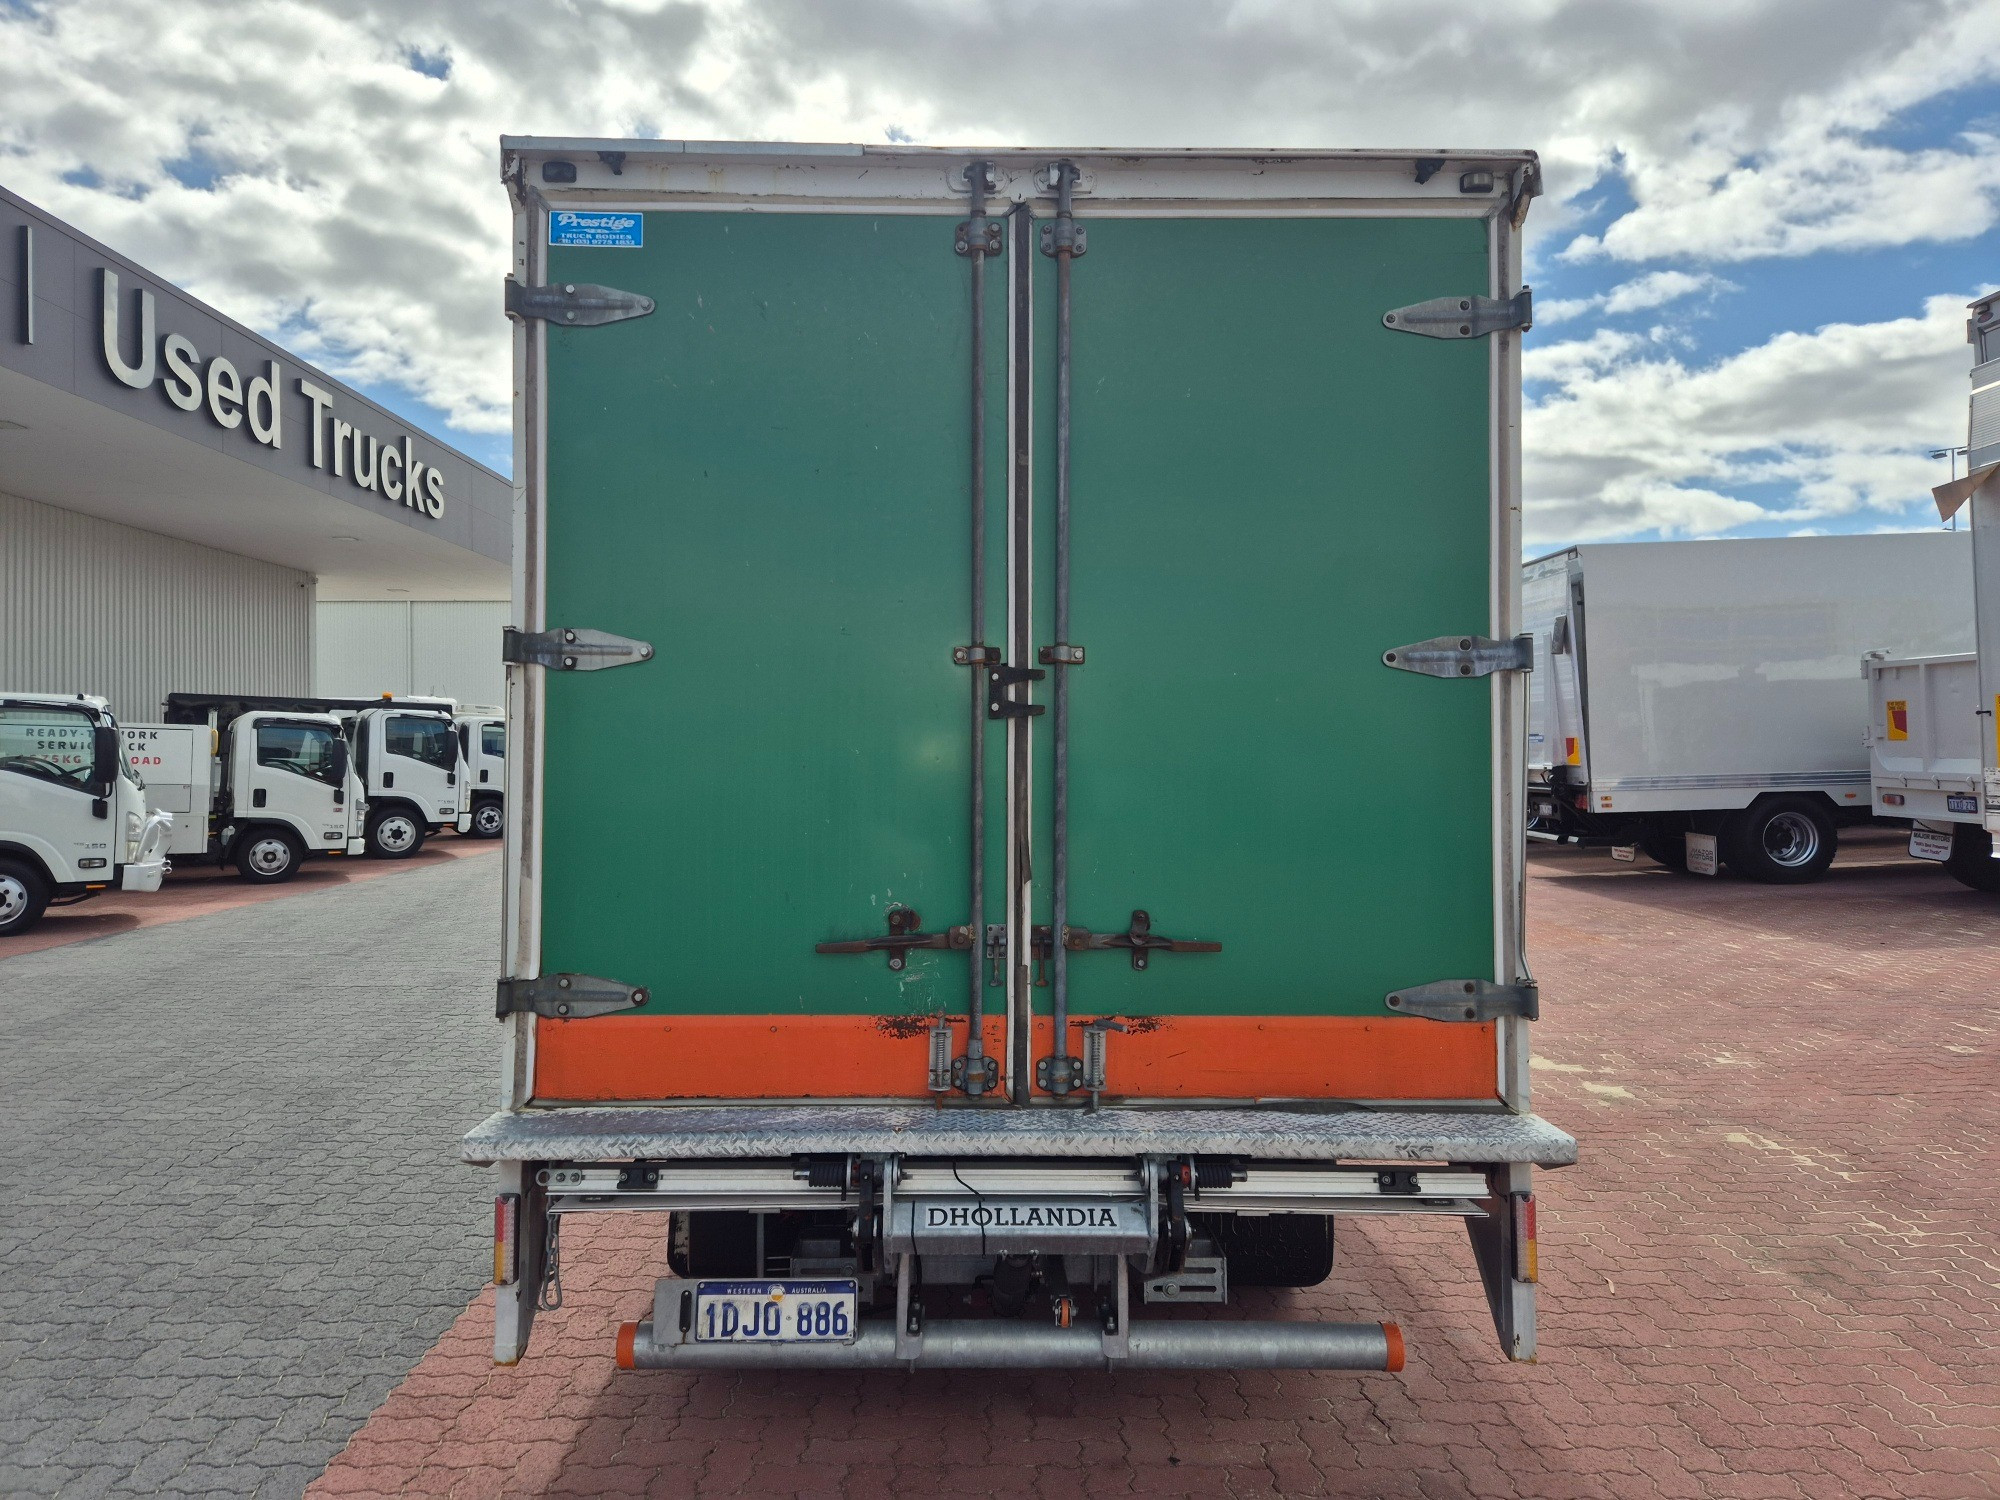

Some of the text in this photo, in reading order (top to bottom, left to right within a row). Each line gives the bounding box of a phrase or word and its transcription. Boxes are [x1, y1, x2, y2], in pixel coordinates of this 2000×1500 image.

[557, 213, 636, 230] Prestige
[98, 266, 446, 520] Used Trucks
[37, 740, 94, 750] SERVIC
[927, 1207, 1117, 1227] DHOLLANDIA
[796, 1300, 849, 1337] 886
